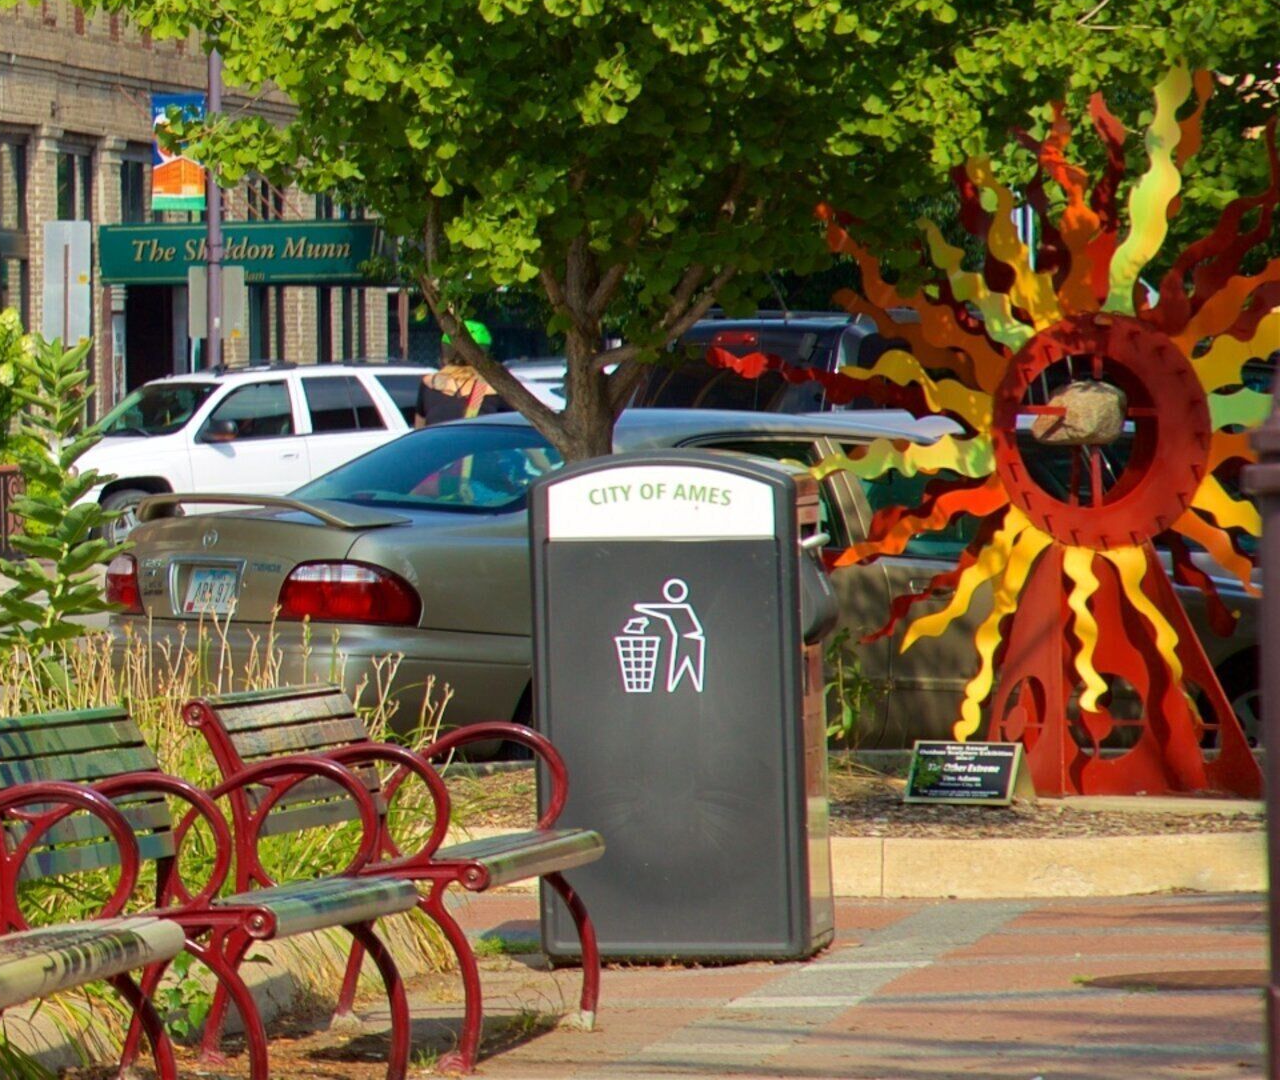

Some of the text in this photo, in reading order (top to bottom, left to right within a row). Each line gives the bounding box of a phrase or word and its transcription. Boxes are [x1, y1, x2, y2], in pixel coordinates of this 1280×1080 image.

[132, 239, 177, 262] The
[281, 236, 351, 260] Munn
[588, 482, 732, 506] CITY OF AMES
[943, 763, 967, 773] Other
[967, 764, 1001, 773] Extreme
